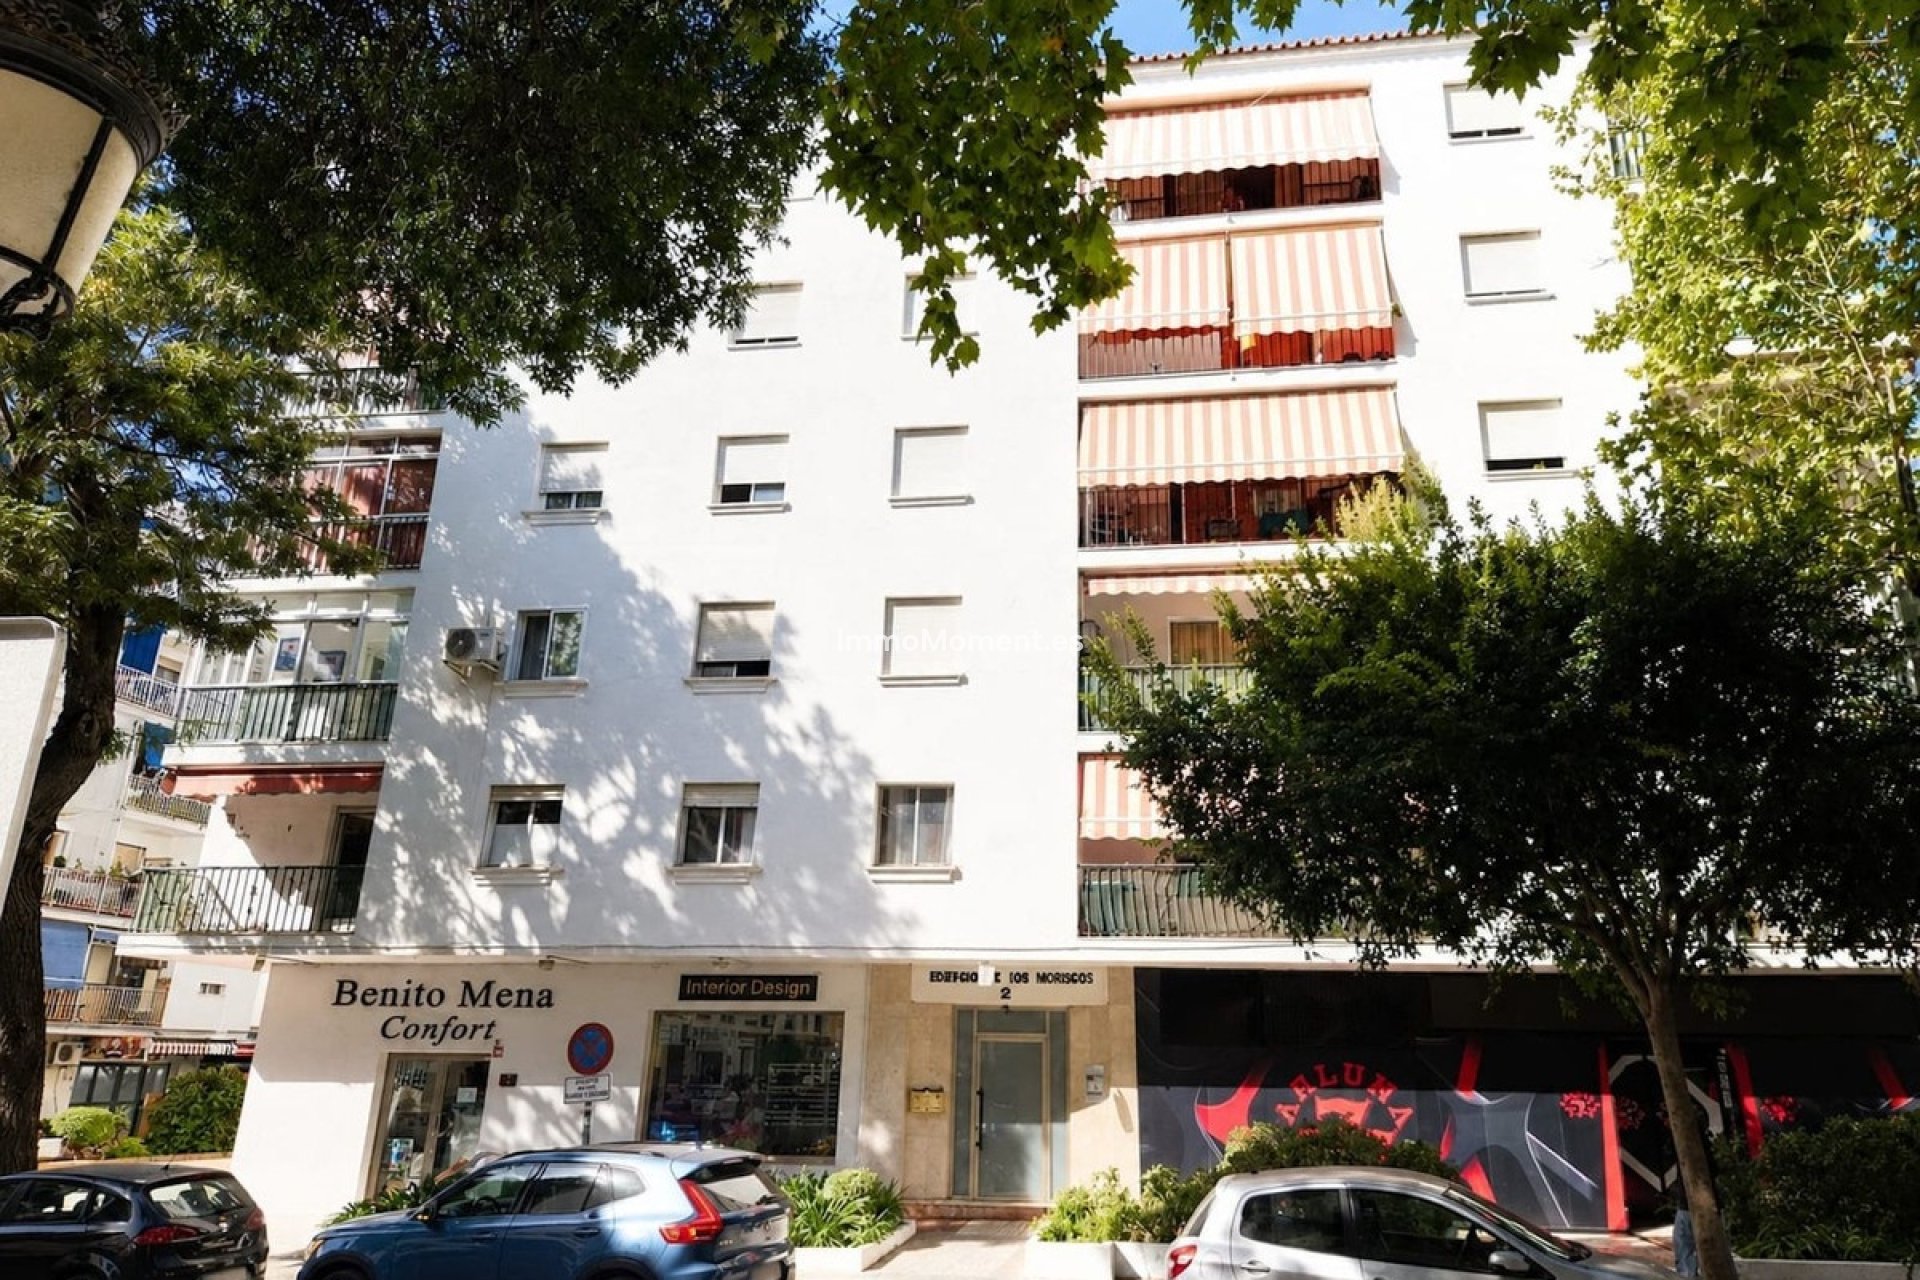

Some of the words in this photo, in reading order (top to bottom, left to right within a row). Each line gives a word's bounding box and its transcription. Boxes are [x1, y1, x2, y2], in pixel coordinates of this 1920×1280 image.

[1036, 971, 1094, 984] MORISCOS
[331, 979, 446, 1008] Benito
[457, 980, 555, 1009] Mena
[686, 979, 747, 995] Interior
[751, 979, 811, 999] Design
[1000, 986, 1012, 999] 2
[380, 1015, 497, 1046] Confort
